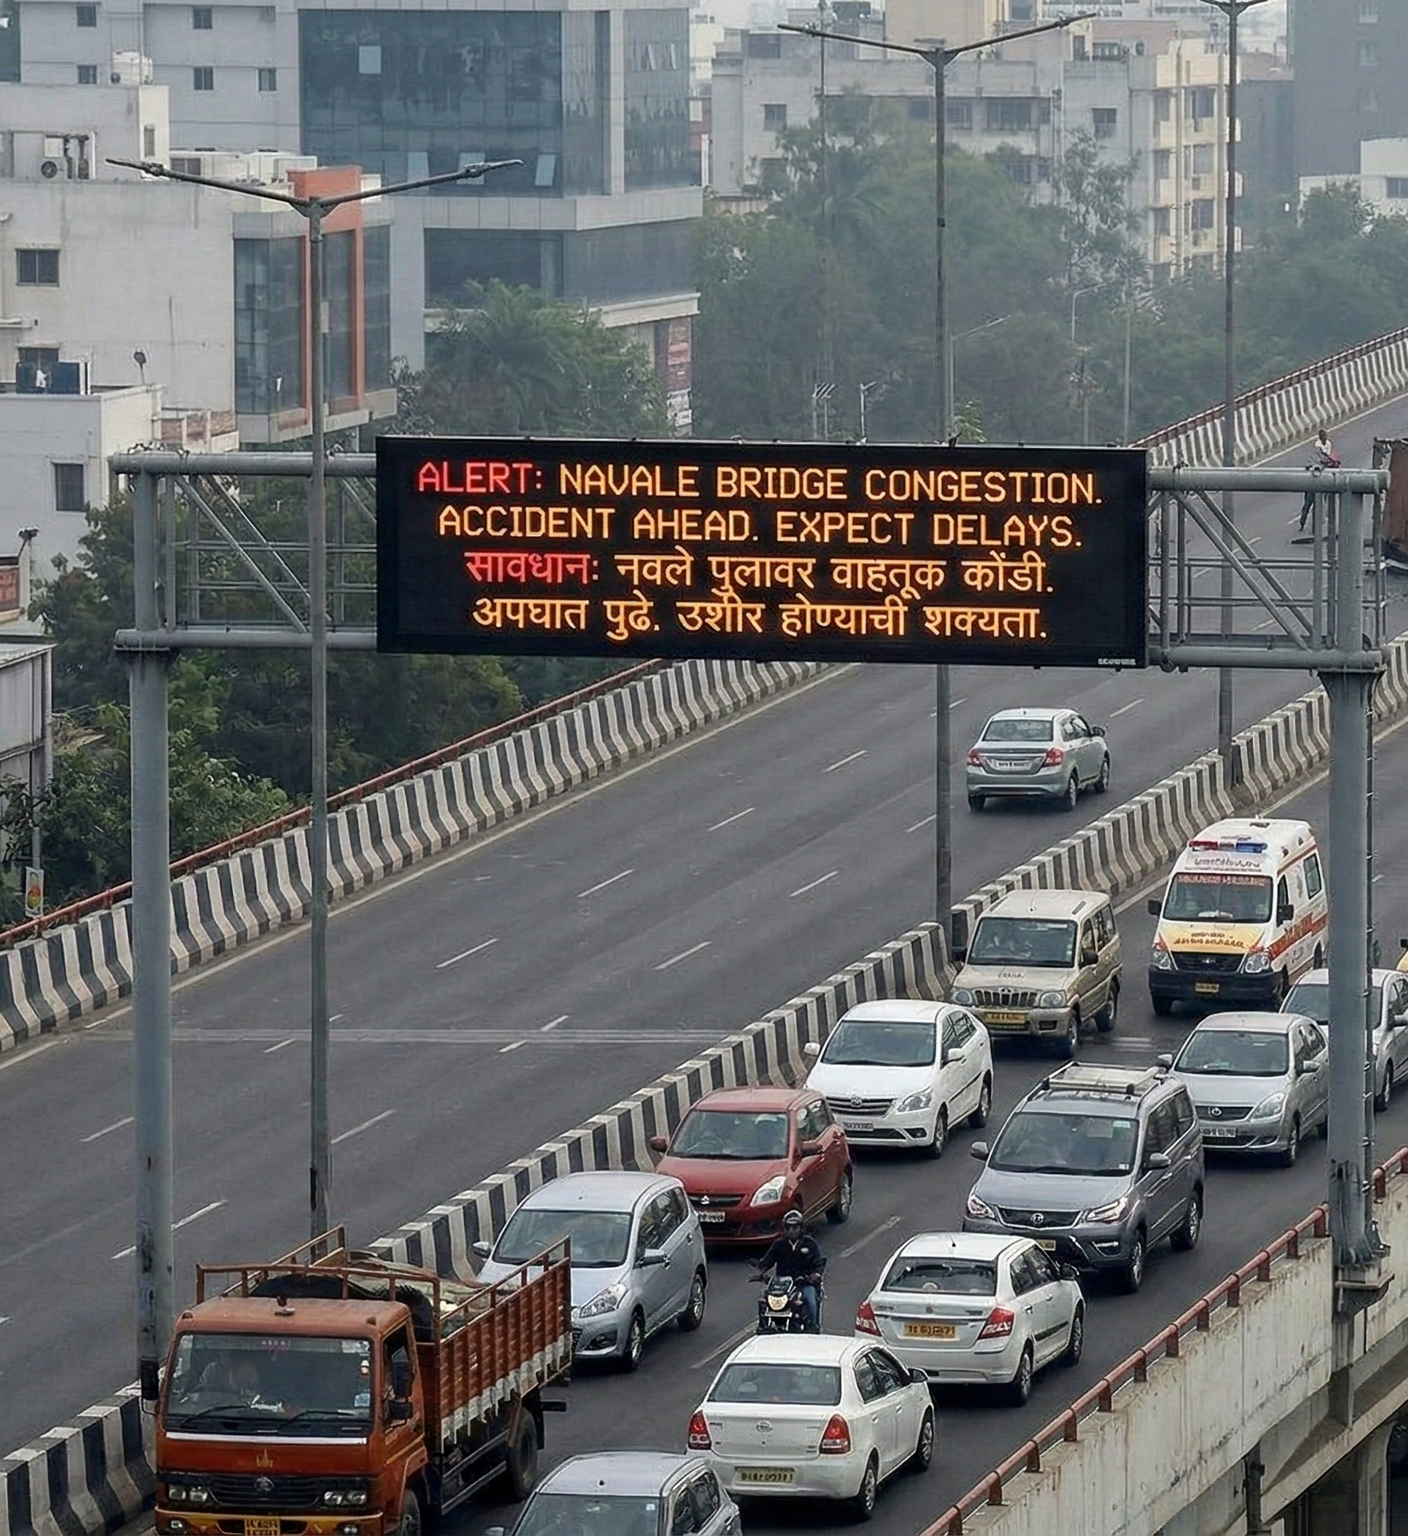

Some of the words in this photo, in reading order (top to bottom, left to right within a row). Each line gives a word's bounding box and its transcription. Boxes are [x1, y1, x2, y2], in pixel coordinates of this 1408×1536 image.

[418, 462, 541, 494] ALERT:
[560, 463, 699, 497] NAVALE
[717, 466, 848, 500] BRIDGE
[865, 469, 1102, 504] CONGESTION.
[439, 505, 615, 539] ACCIDENT
[633, 508, 758, 541] AHEAD.
[776, 511, 915, 545] EXPECT
[933, 513, 1082, 547] DELAYS.
[464, 552, 599, 585] सावधान:
[614, 545, 695, 586] नवले
[707, 556, 817, 596] पुलावर
[830, 558, 947, 600] वाहतूक
[961, 550, 1053, 593] कोंडी.
[472, 597, 590, 630] अपघात
[602, 589, 660, 641] पुढे.
[675, 592, 766, 633] उशीर
[778, 592, 908, 637] होण्याची
[922, 606, 1047, 638] शक्यता.
